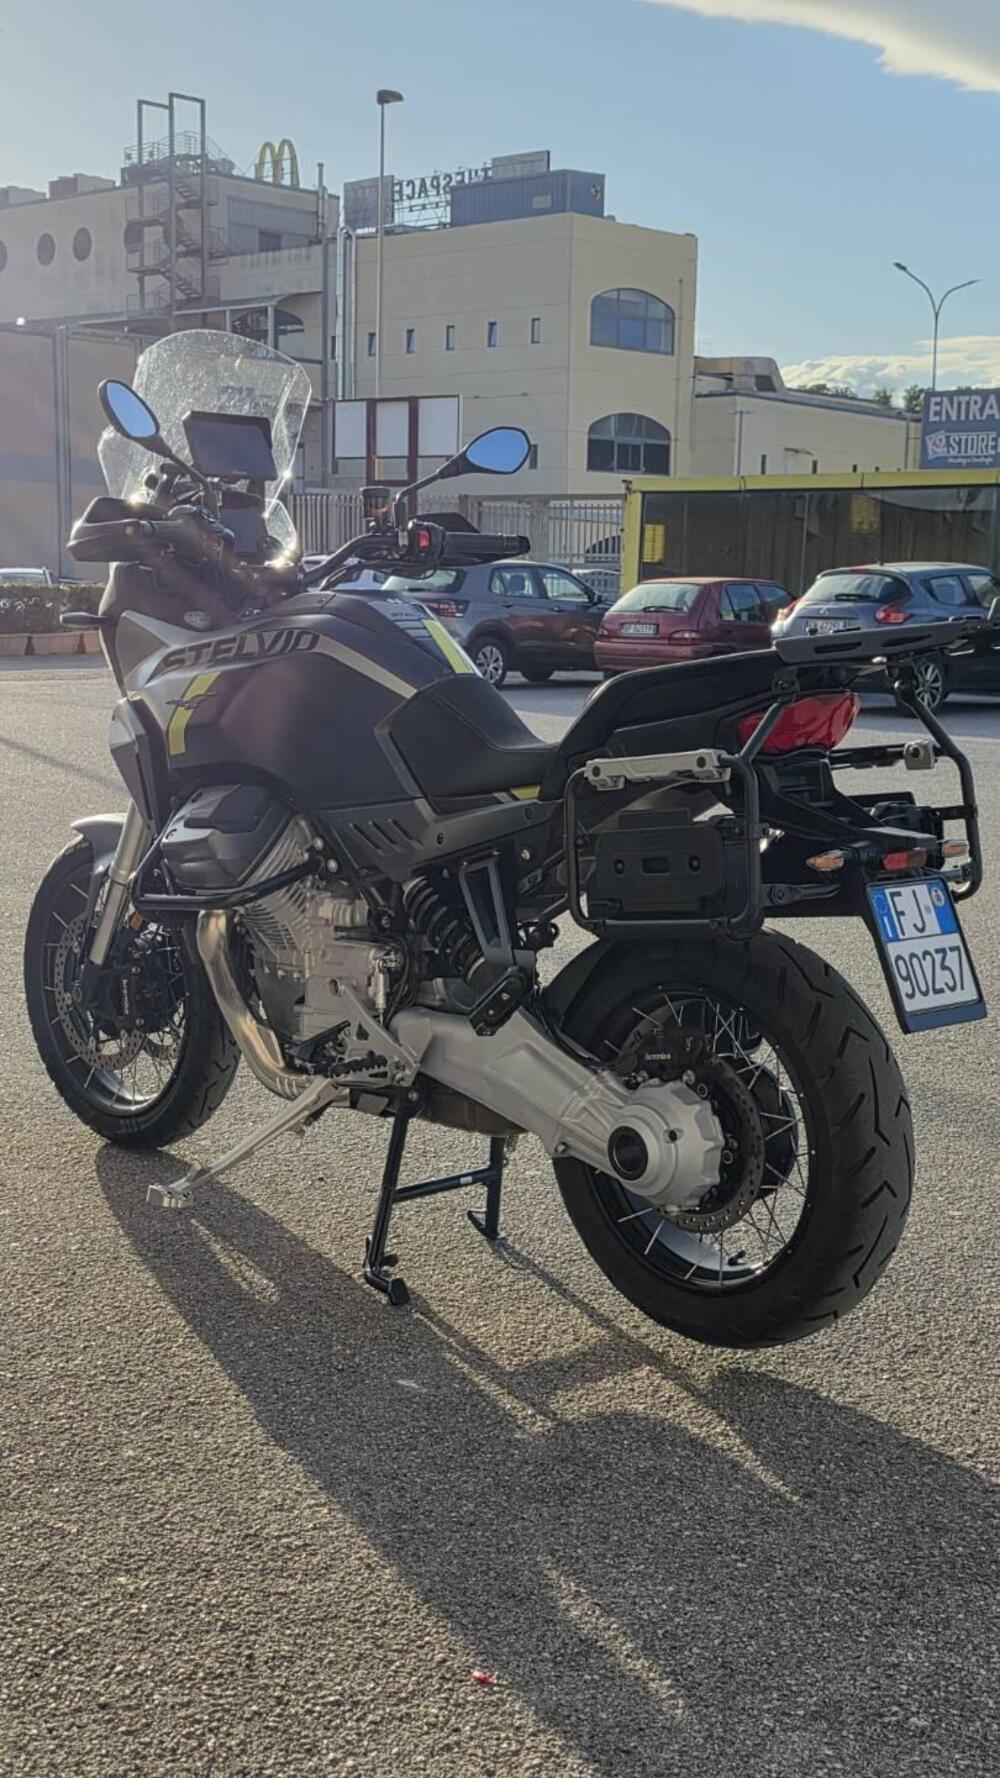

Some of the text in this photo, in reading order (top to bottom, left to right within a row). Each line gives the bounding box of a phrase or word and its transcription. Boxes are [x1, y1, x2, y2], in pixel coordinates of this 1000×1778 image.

[928, 395, 1000, 422] ENTRA
[949, 433, 997, 456] STORE
[164, 629, 320, 668] STELVIO
[889, 889, 926, 937] FJ
[894, 945, 965, 1000] 90237
